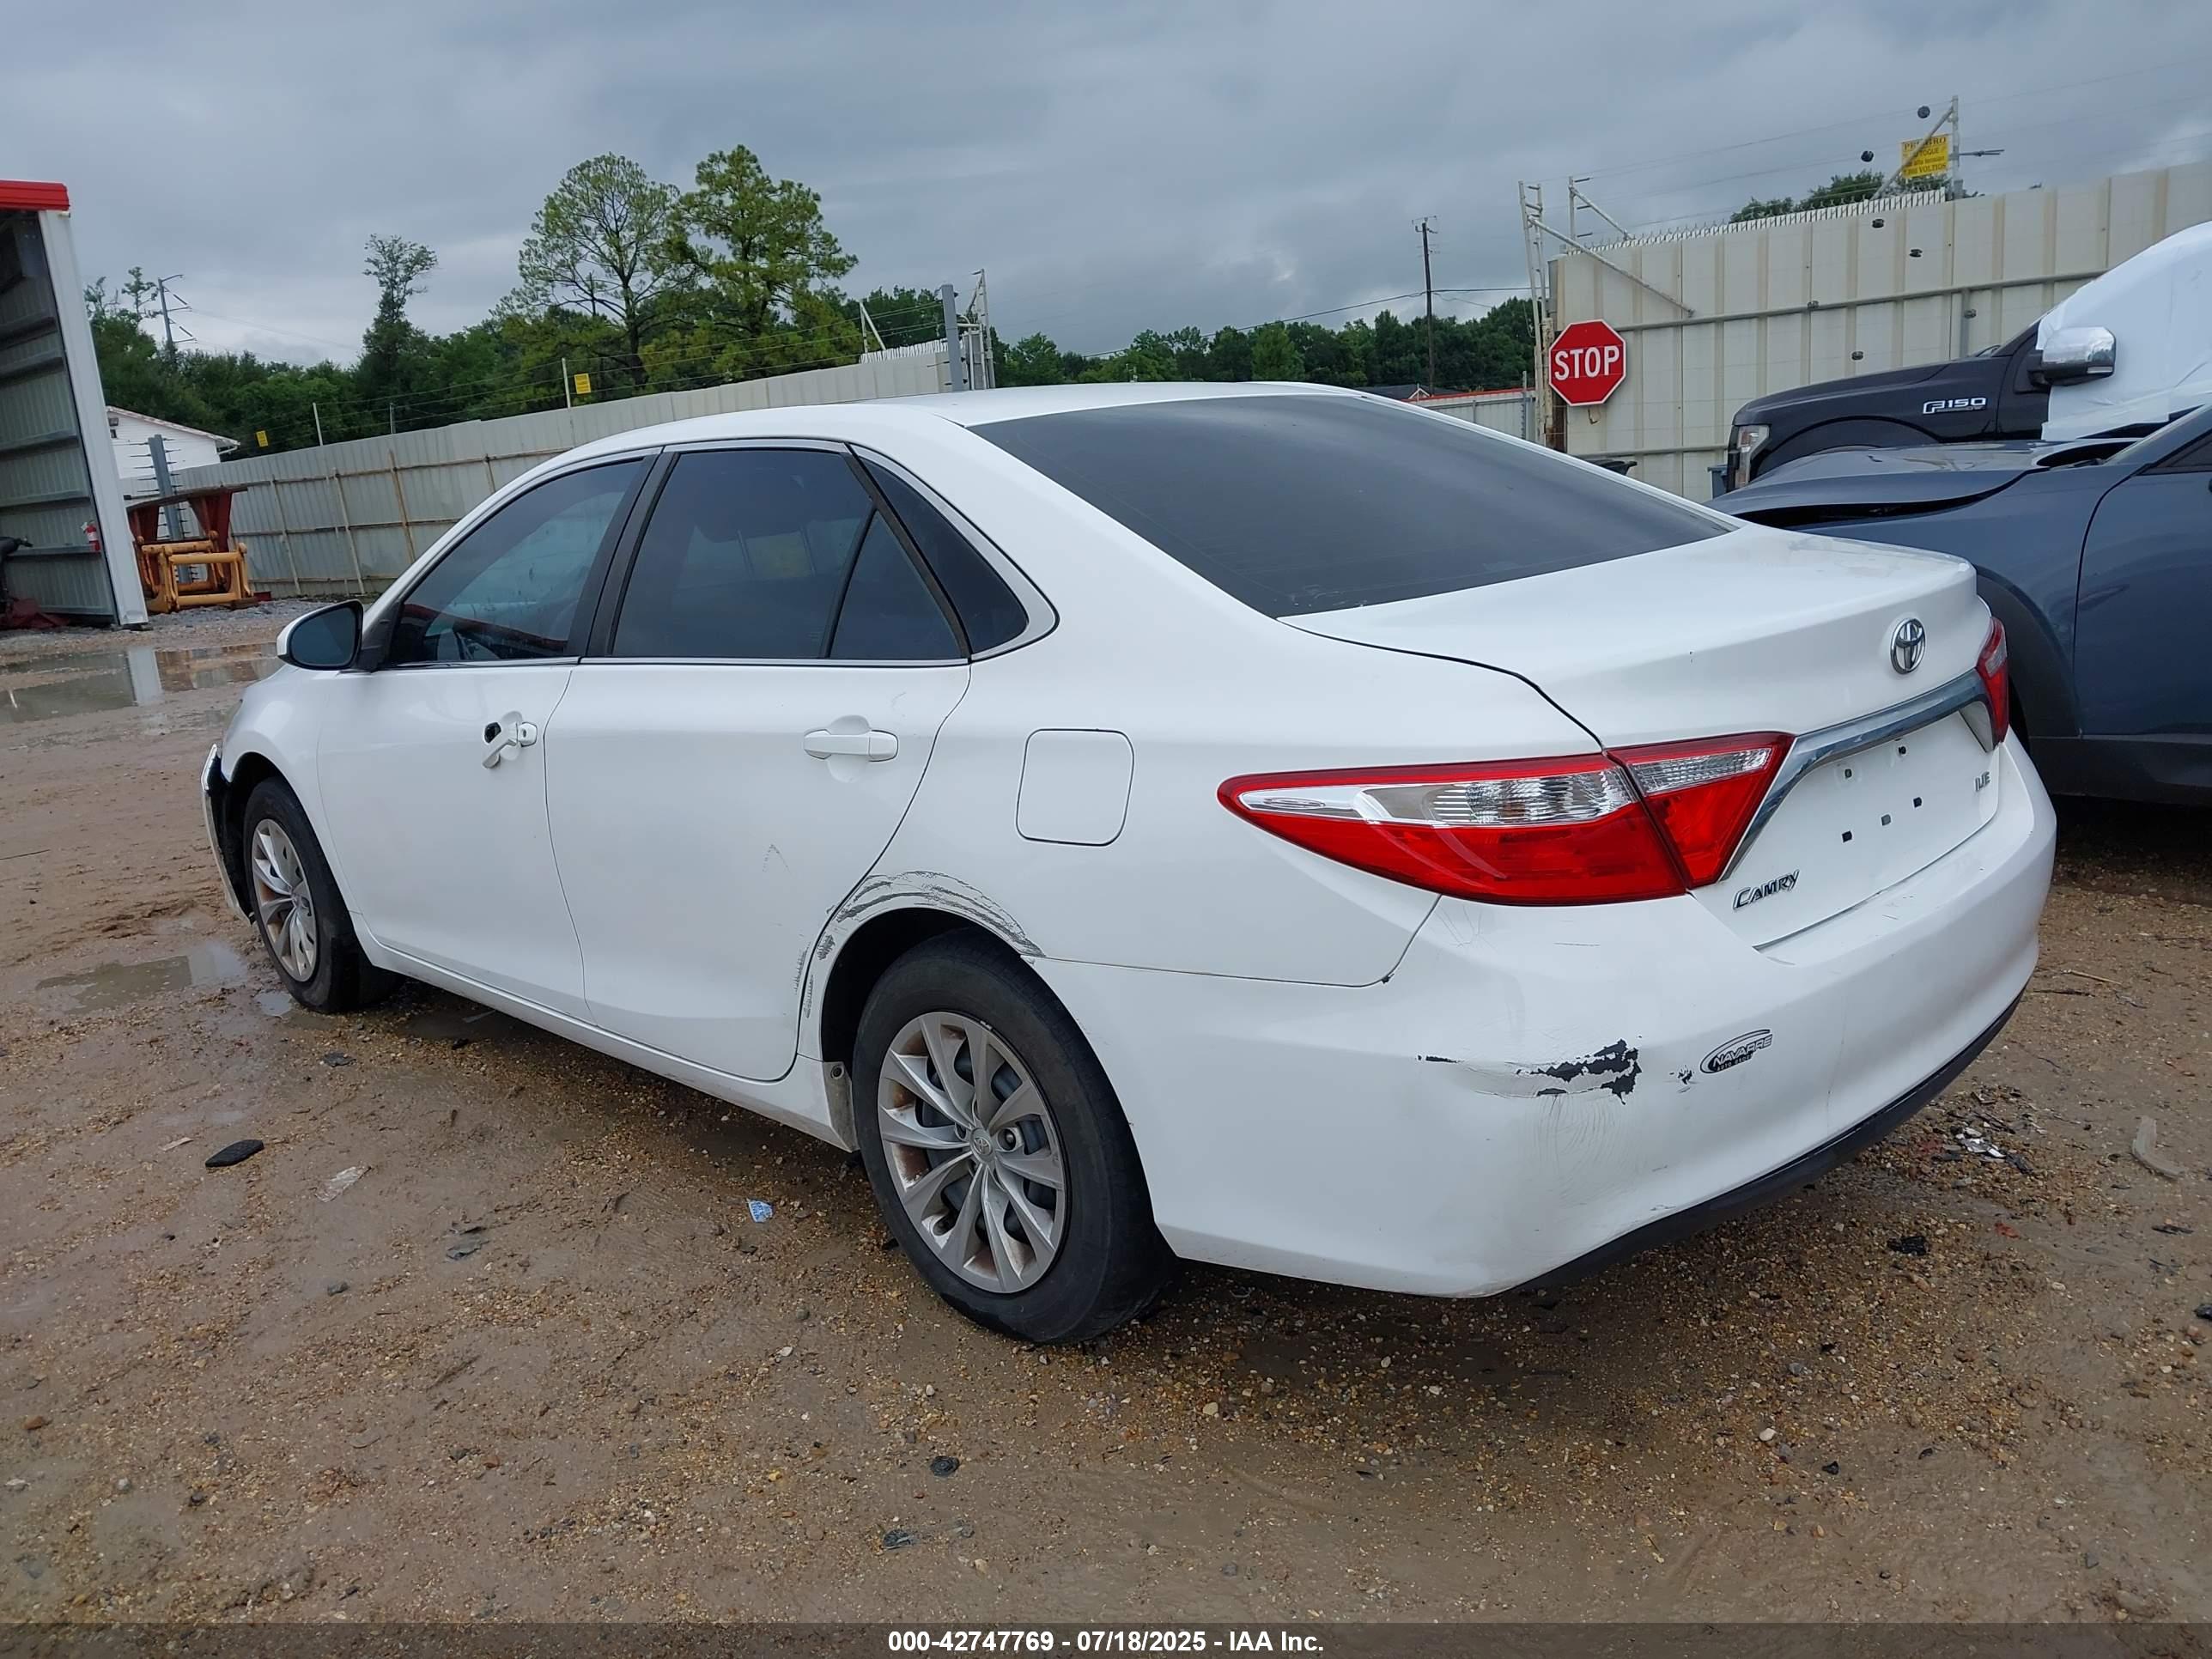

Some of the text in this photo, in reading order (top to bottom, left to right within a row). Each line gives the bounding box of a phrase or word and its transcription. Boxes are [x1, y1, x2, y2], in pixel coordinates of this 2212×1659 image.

[1554, 345, 1620, 380] STOP
[1733, 869, 1800, 910] CAMRY
[1712, 1034, 1773, 1067] NAVARRE
